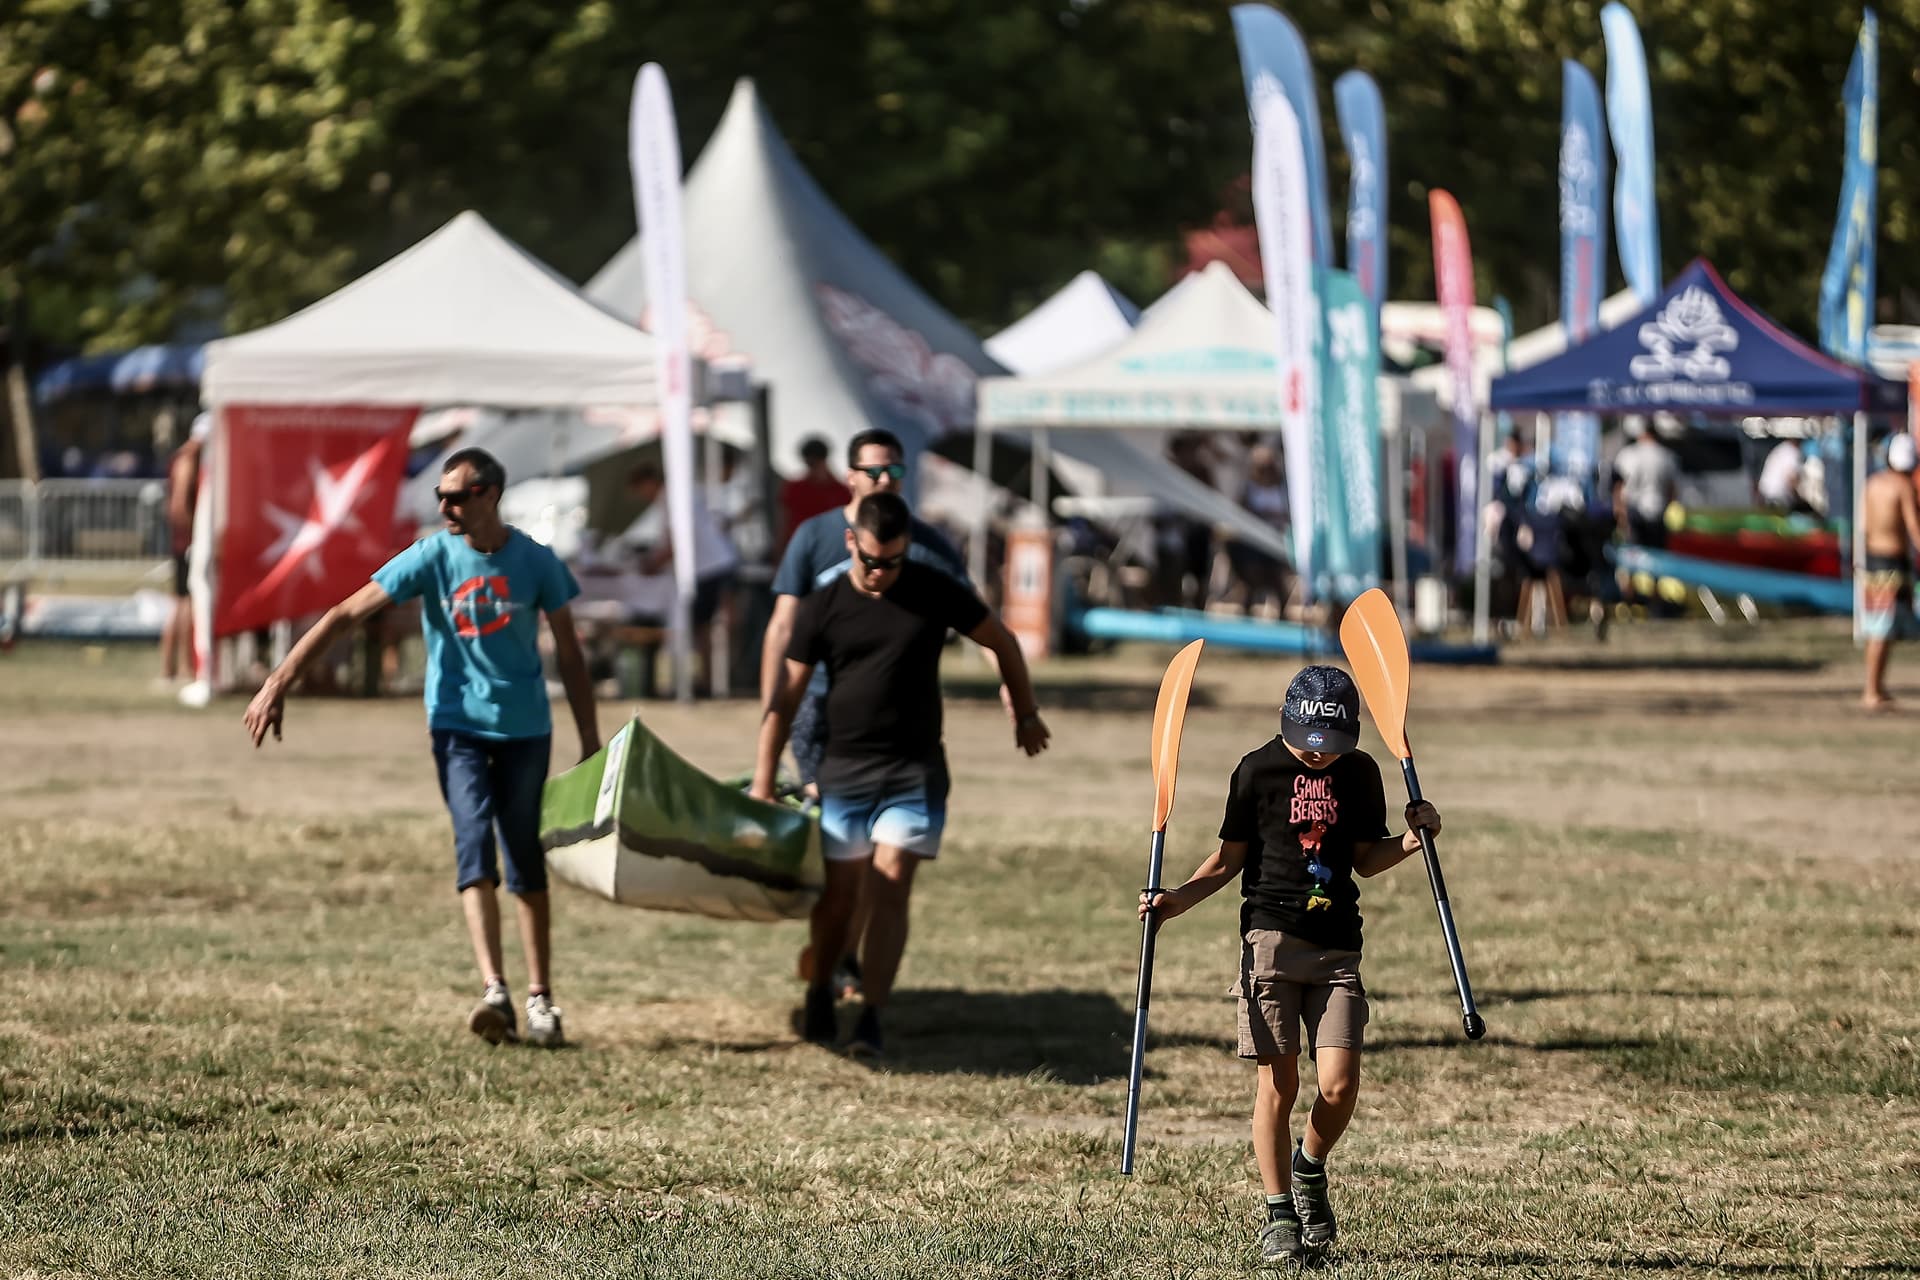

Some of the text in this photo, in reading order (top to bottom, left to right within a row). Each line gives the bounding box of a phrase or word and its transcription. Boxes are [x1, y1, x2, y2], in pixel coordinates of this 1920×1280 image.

[1300, 700, 1347, 719] NASA
[1294, 775, 1332, 800] GANG
[1289, 798, 1338, 824] BEASTS
